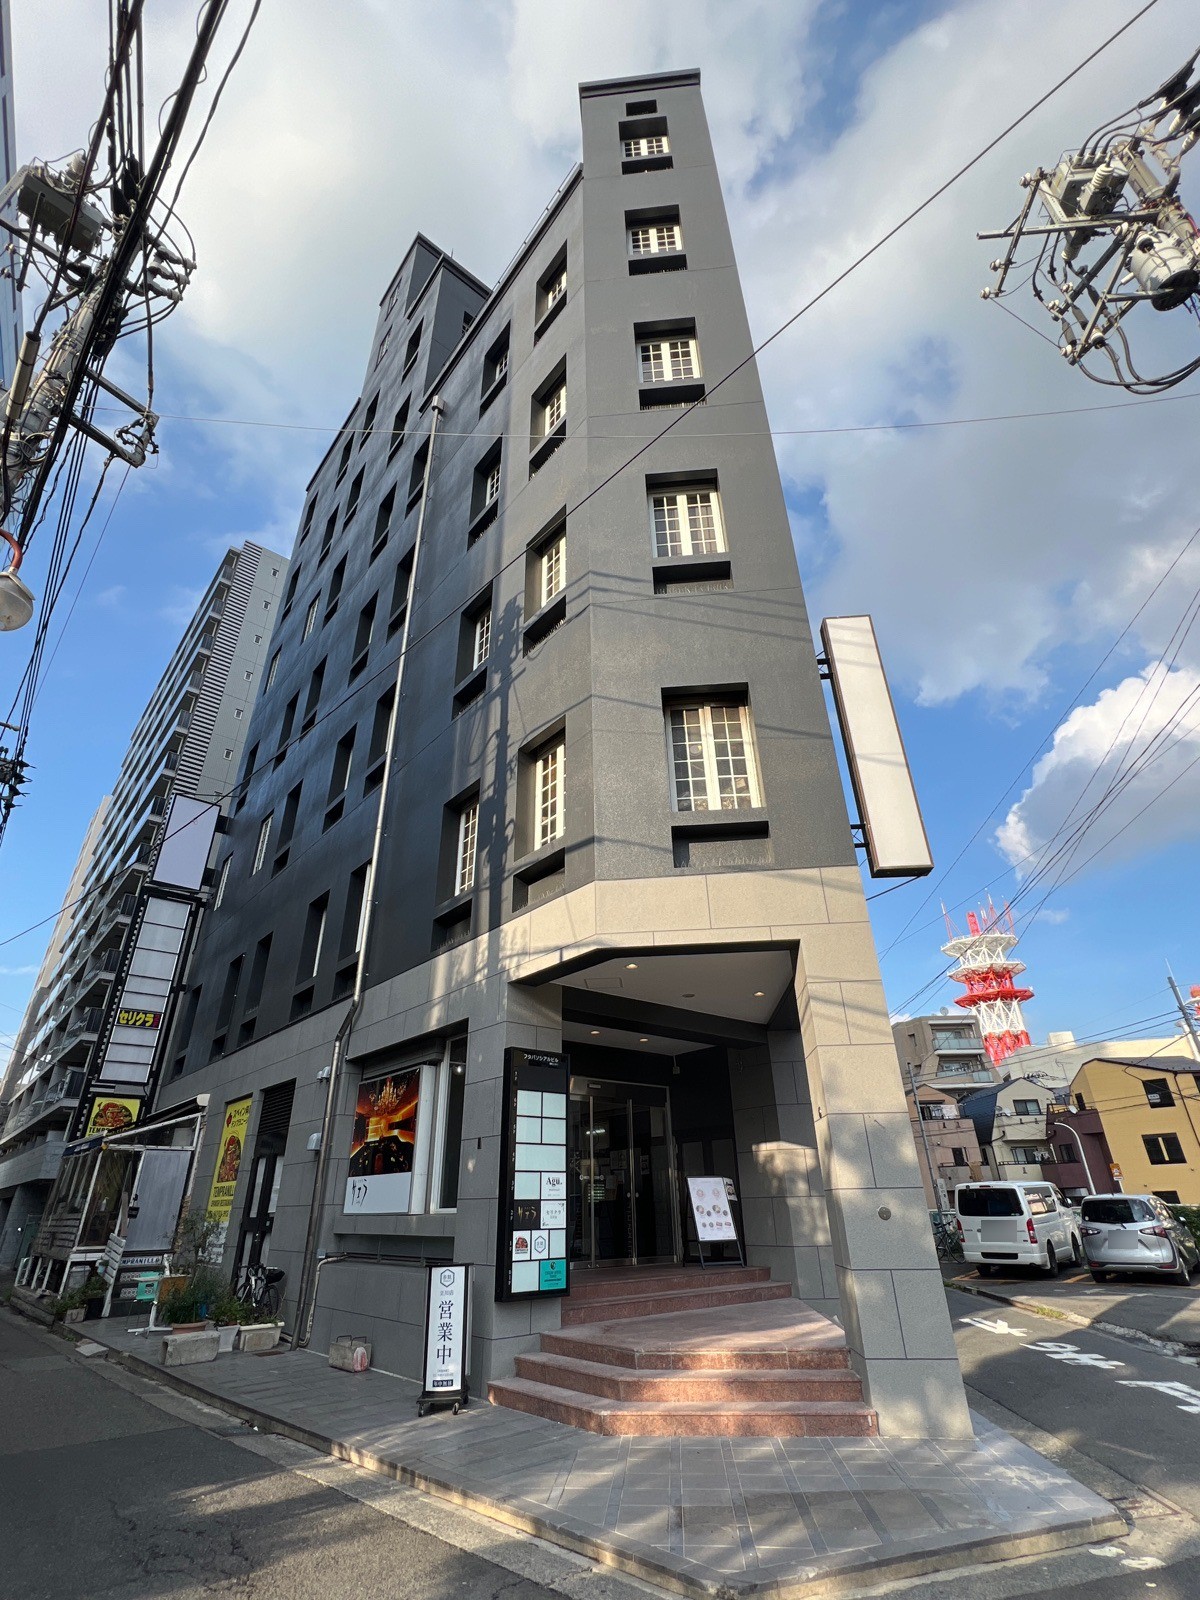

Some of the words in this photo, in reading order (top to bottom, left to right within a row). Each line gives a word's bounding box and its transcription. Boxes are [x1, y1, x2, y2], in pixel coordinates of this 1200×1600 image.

[119, 1010, 154, 1027] セリクラ
[436, 1300, 454, 1365] 営業中
